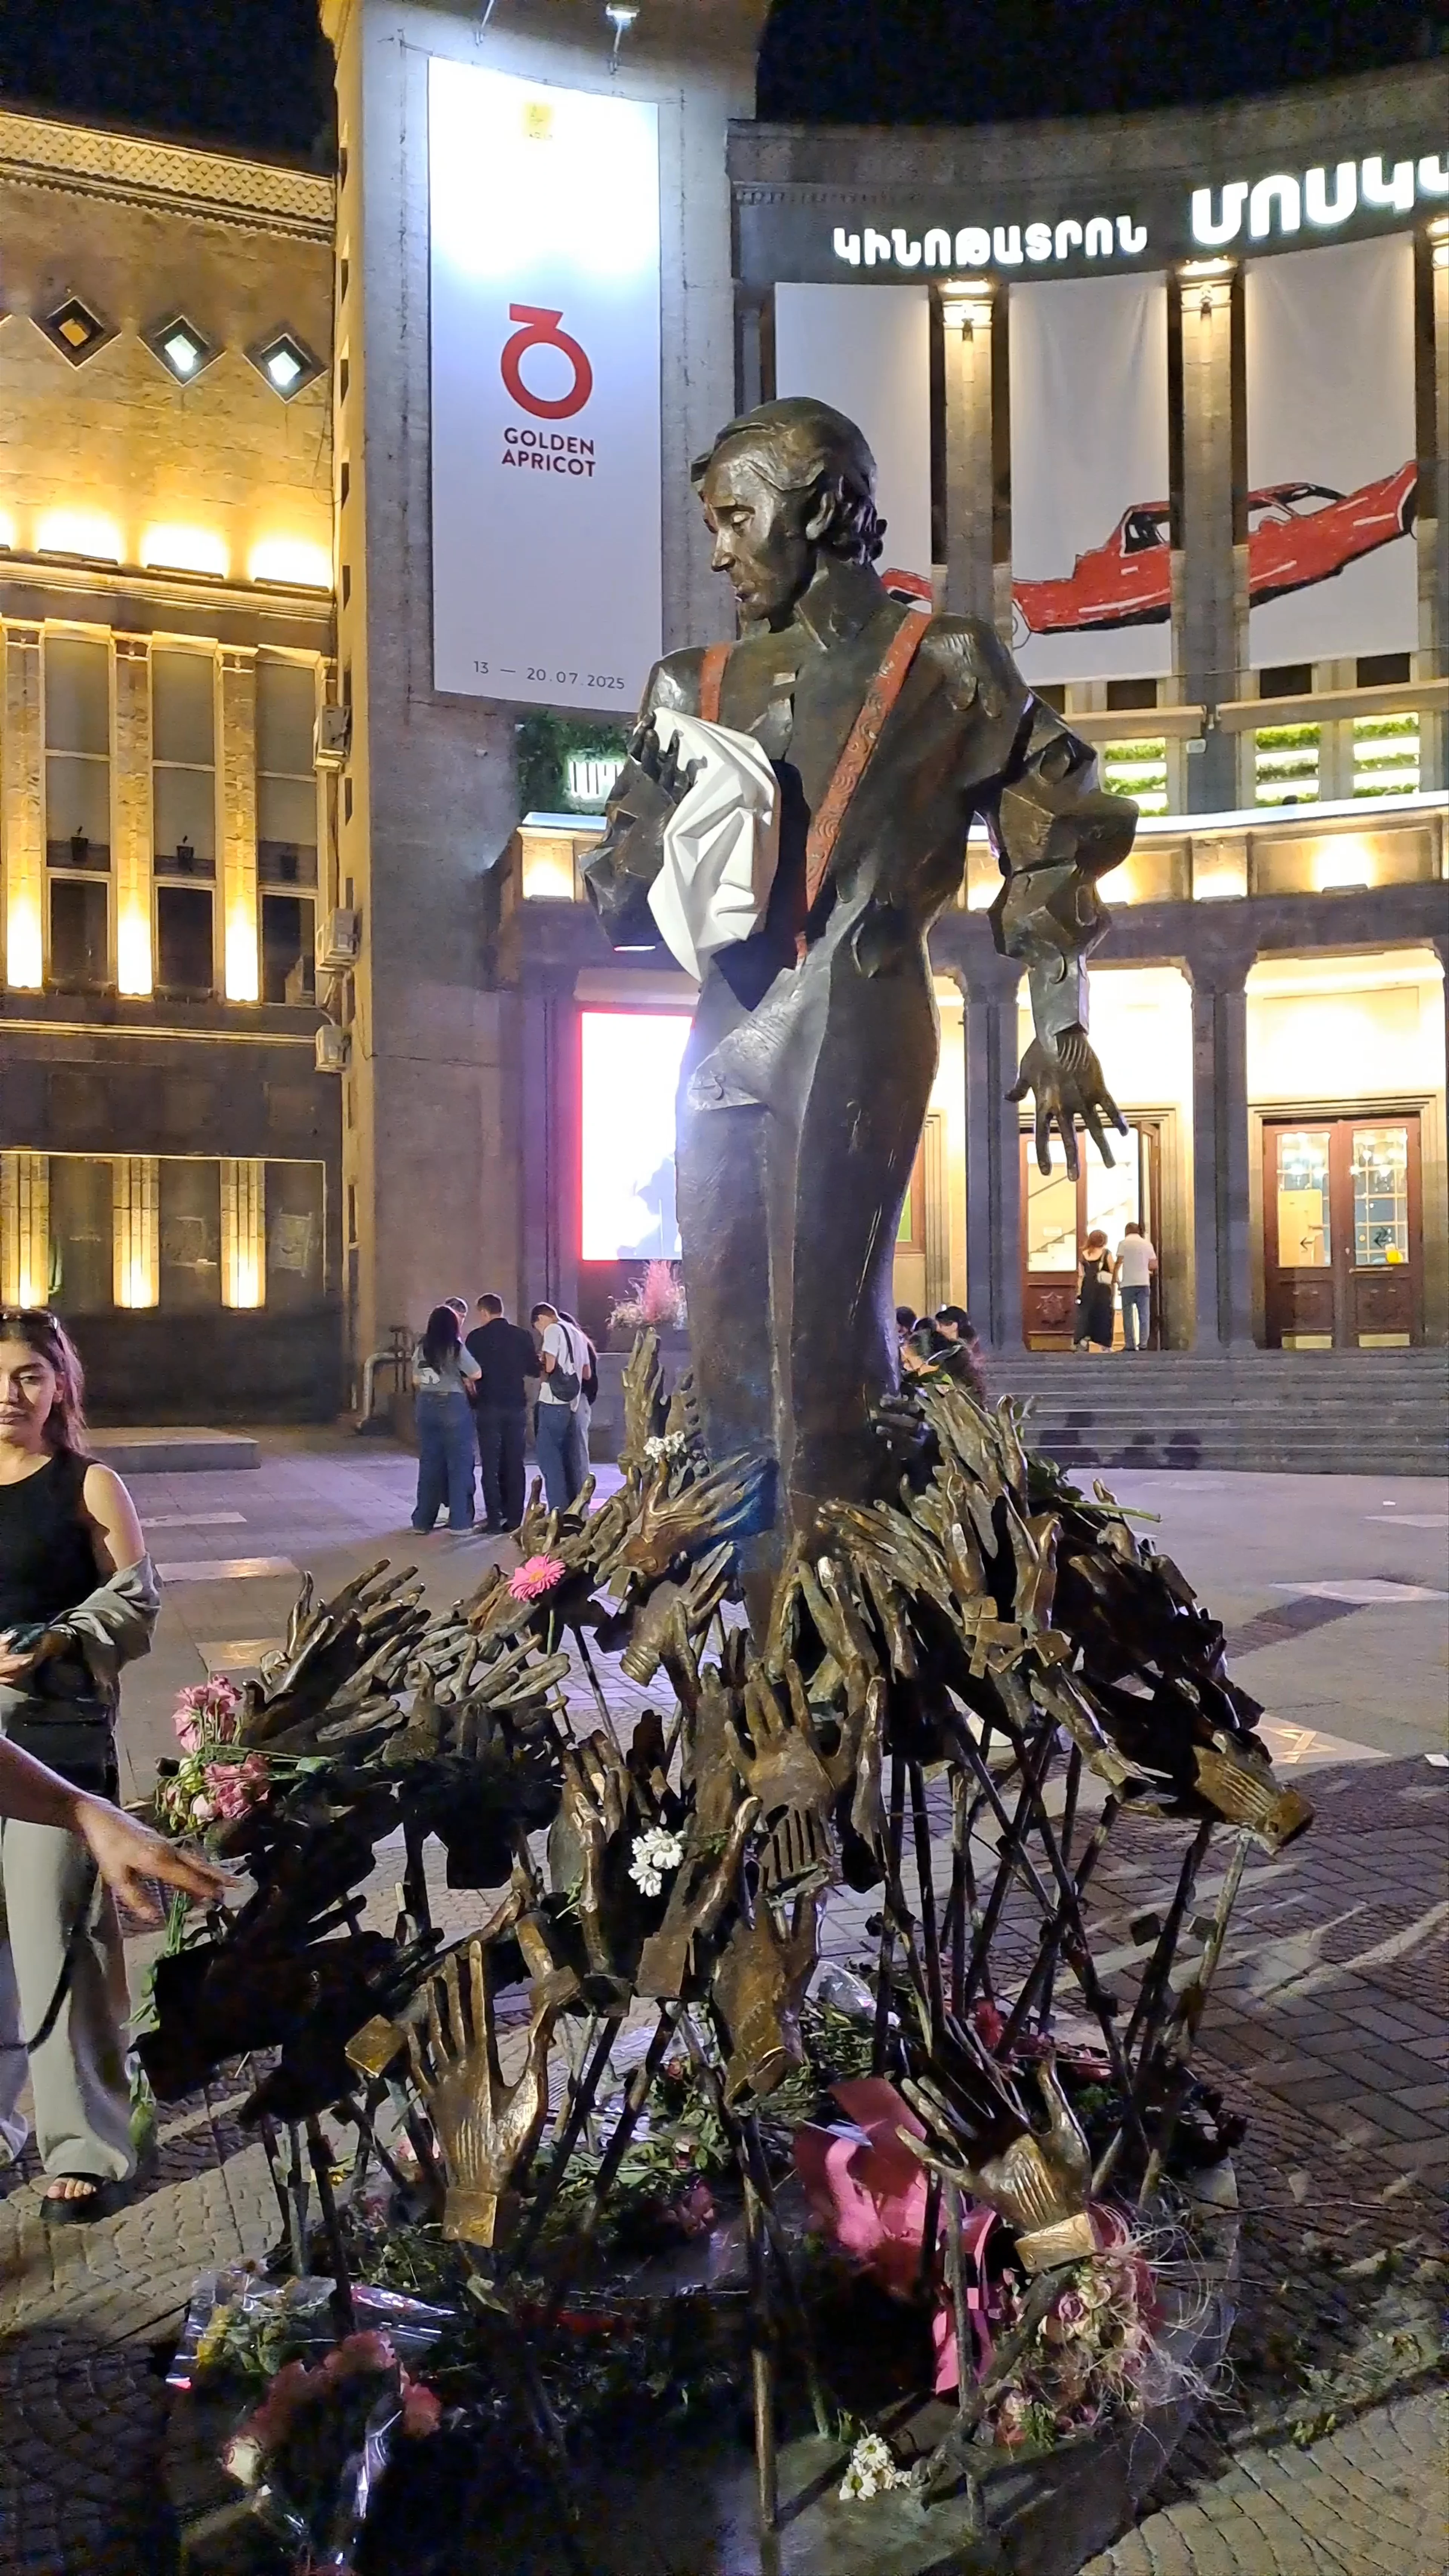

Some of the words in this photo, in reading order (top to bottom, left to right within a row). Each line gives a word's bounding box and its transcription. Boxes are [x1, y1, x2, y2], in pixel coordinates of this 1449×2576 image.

[834, 215, 1147, 267] ԿԻՆՈԹԱՏՐՈՆ
[503, 427, 594, 456] GOLDEN
[501, 448, 596, 477] APRICOT
[473, 660, 489, 674] 13
[526, 667, 625, 690] 20.07.2025
